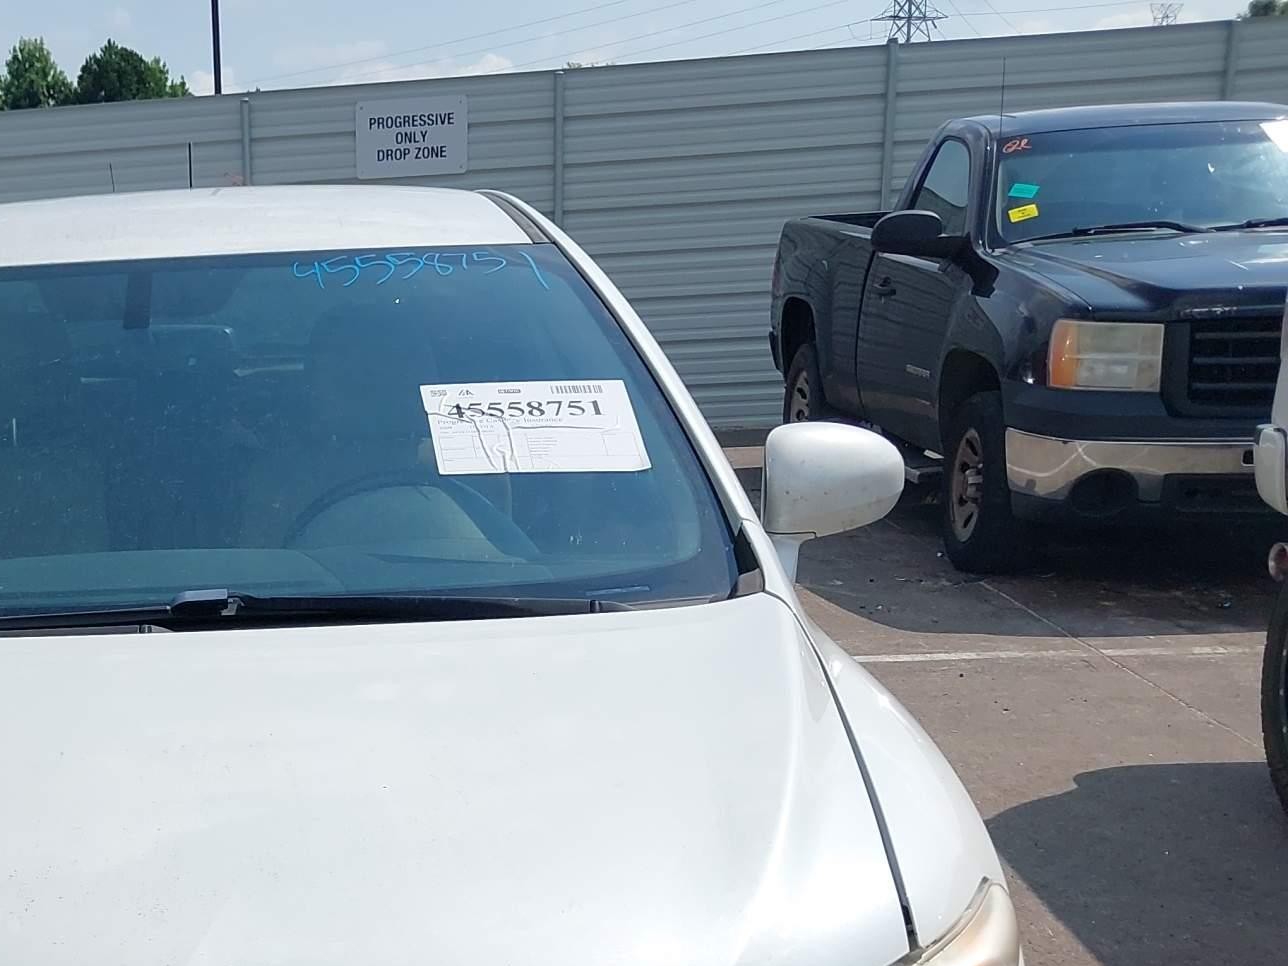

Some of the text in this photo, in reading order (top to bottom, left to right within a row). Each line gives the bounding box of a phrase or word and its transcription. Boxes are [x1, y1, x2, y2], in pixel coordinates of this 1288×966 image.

[368, 112, 455, 130] PROGRESSIVE
[395, 130, 428, 145] ONLY
[376, 145, 447, 162] DROP ZONE
[293, 250, 551, 290] 45558751
[447, 400, 604, 418] 45558751
